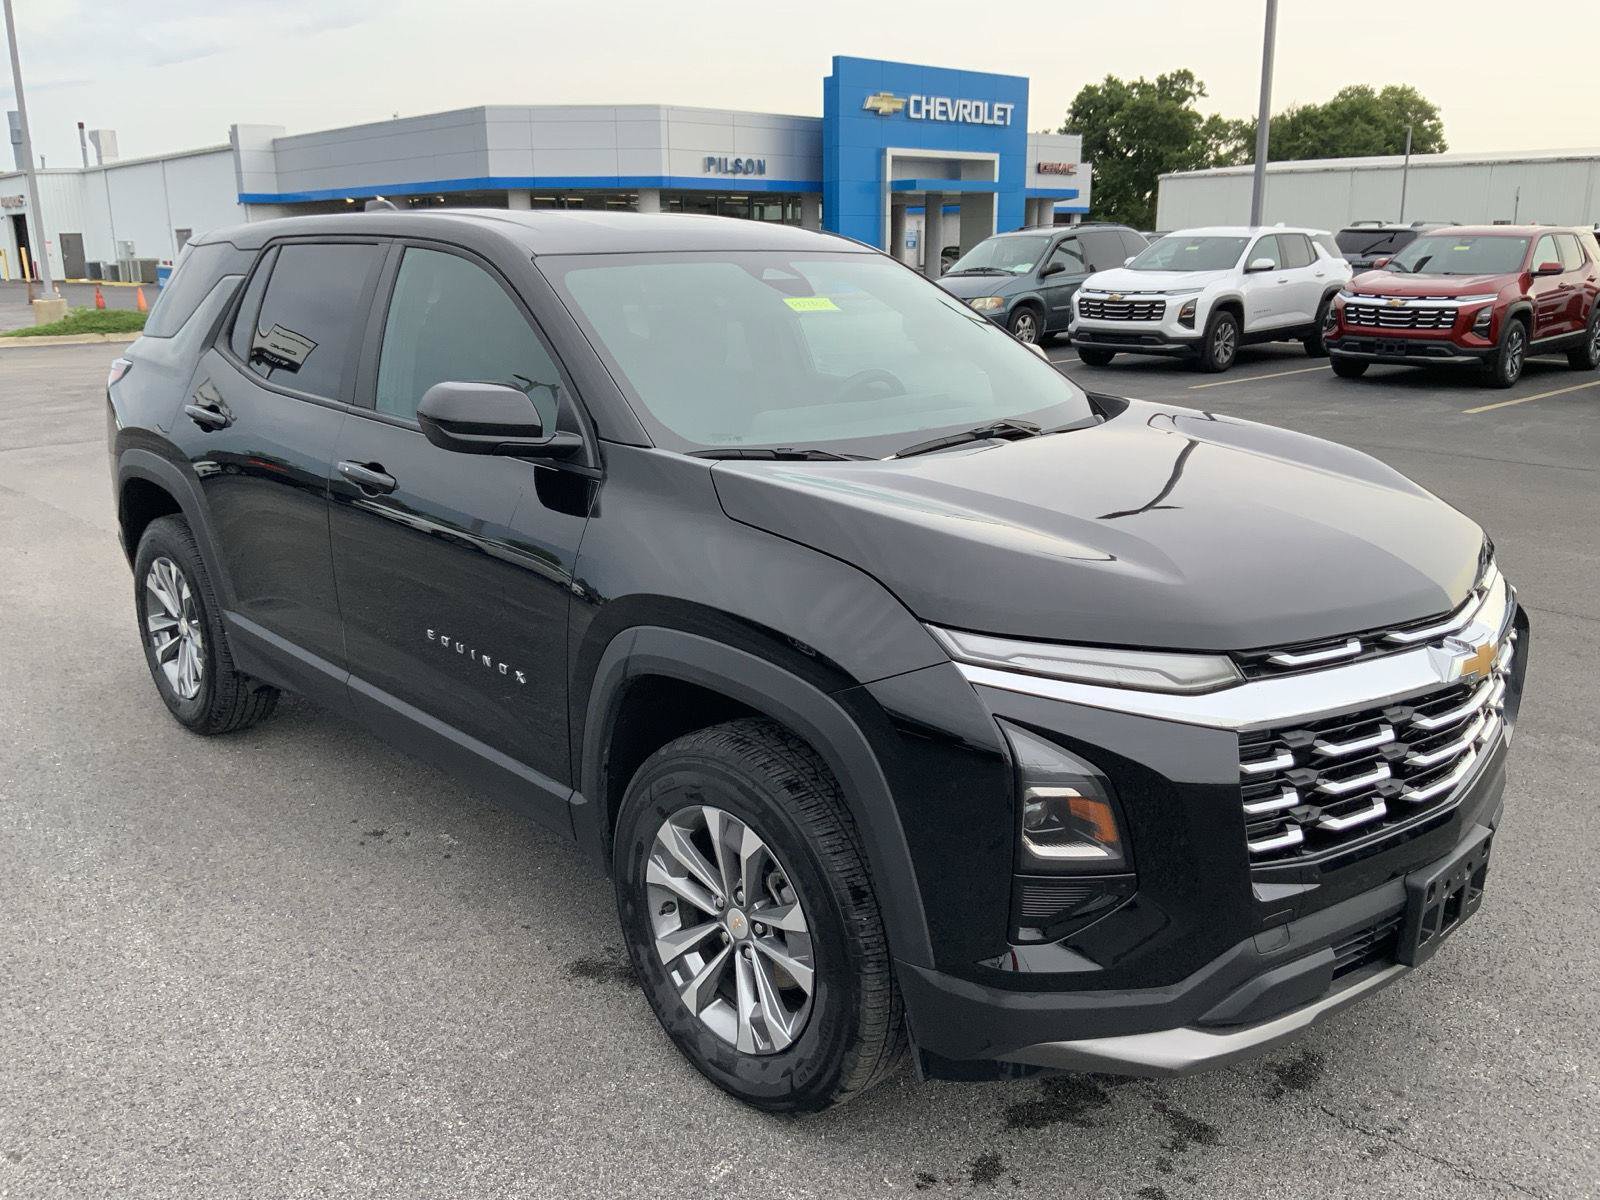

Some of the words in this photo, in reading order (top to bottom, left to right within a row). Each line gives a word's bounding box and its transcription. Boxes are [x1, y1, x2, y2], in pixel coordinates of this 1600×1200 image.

[908, 94, 1015, 126] CHEVROLET
[703, 156, 766, 175] PILSON
[426, 628, 527, 684] EQUINOX
